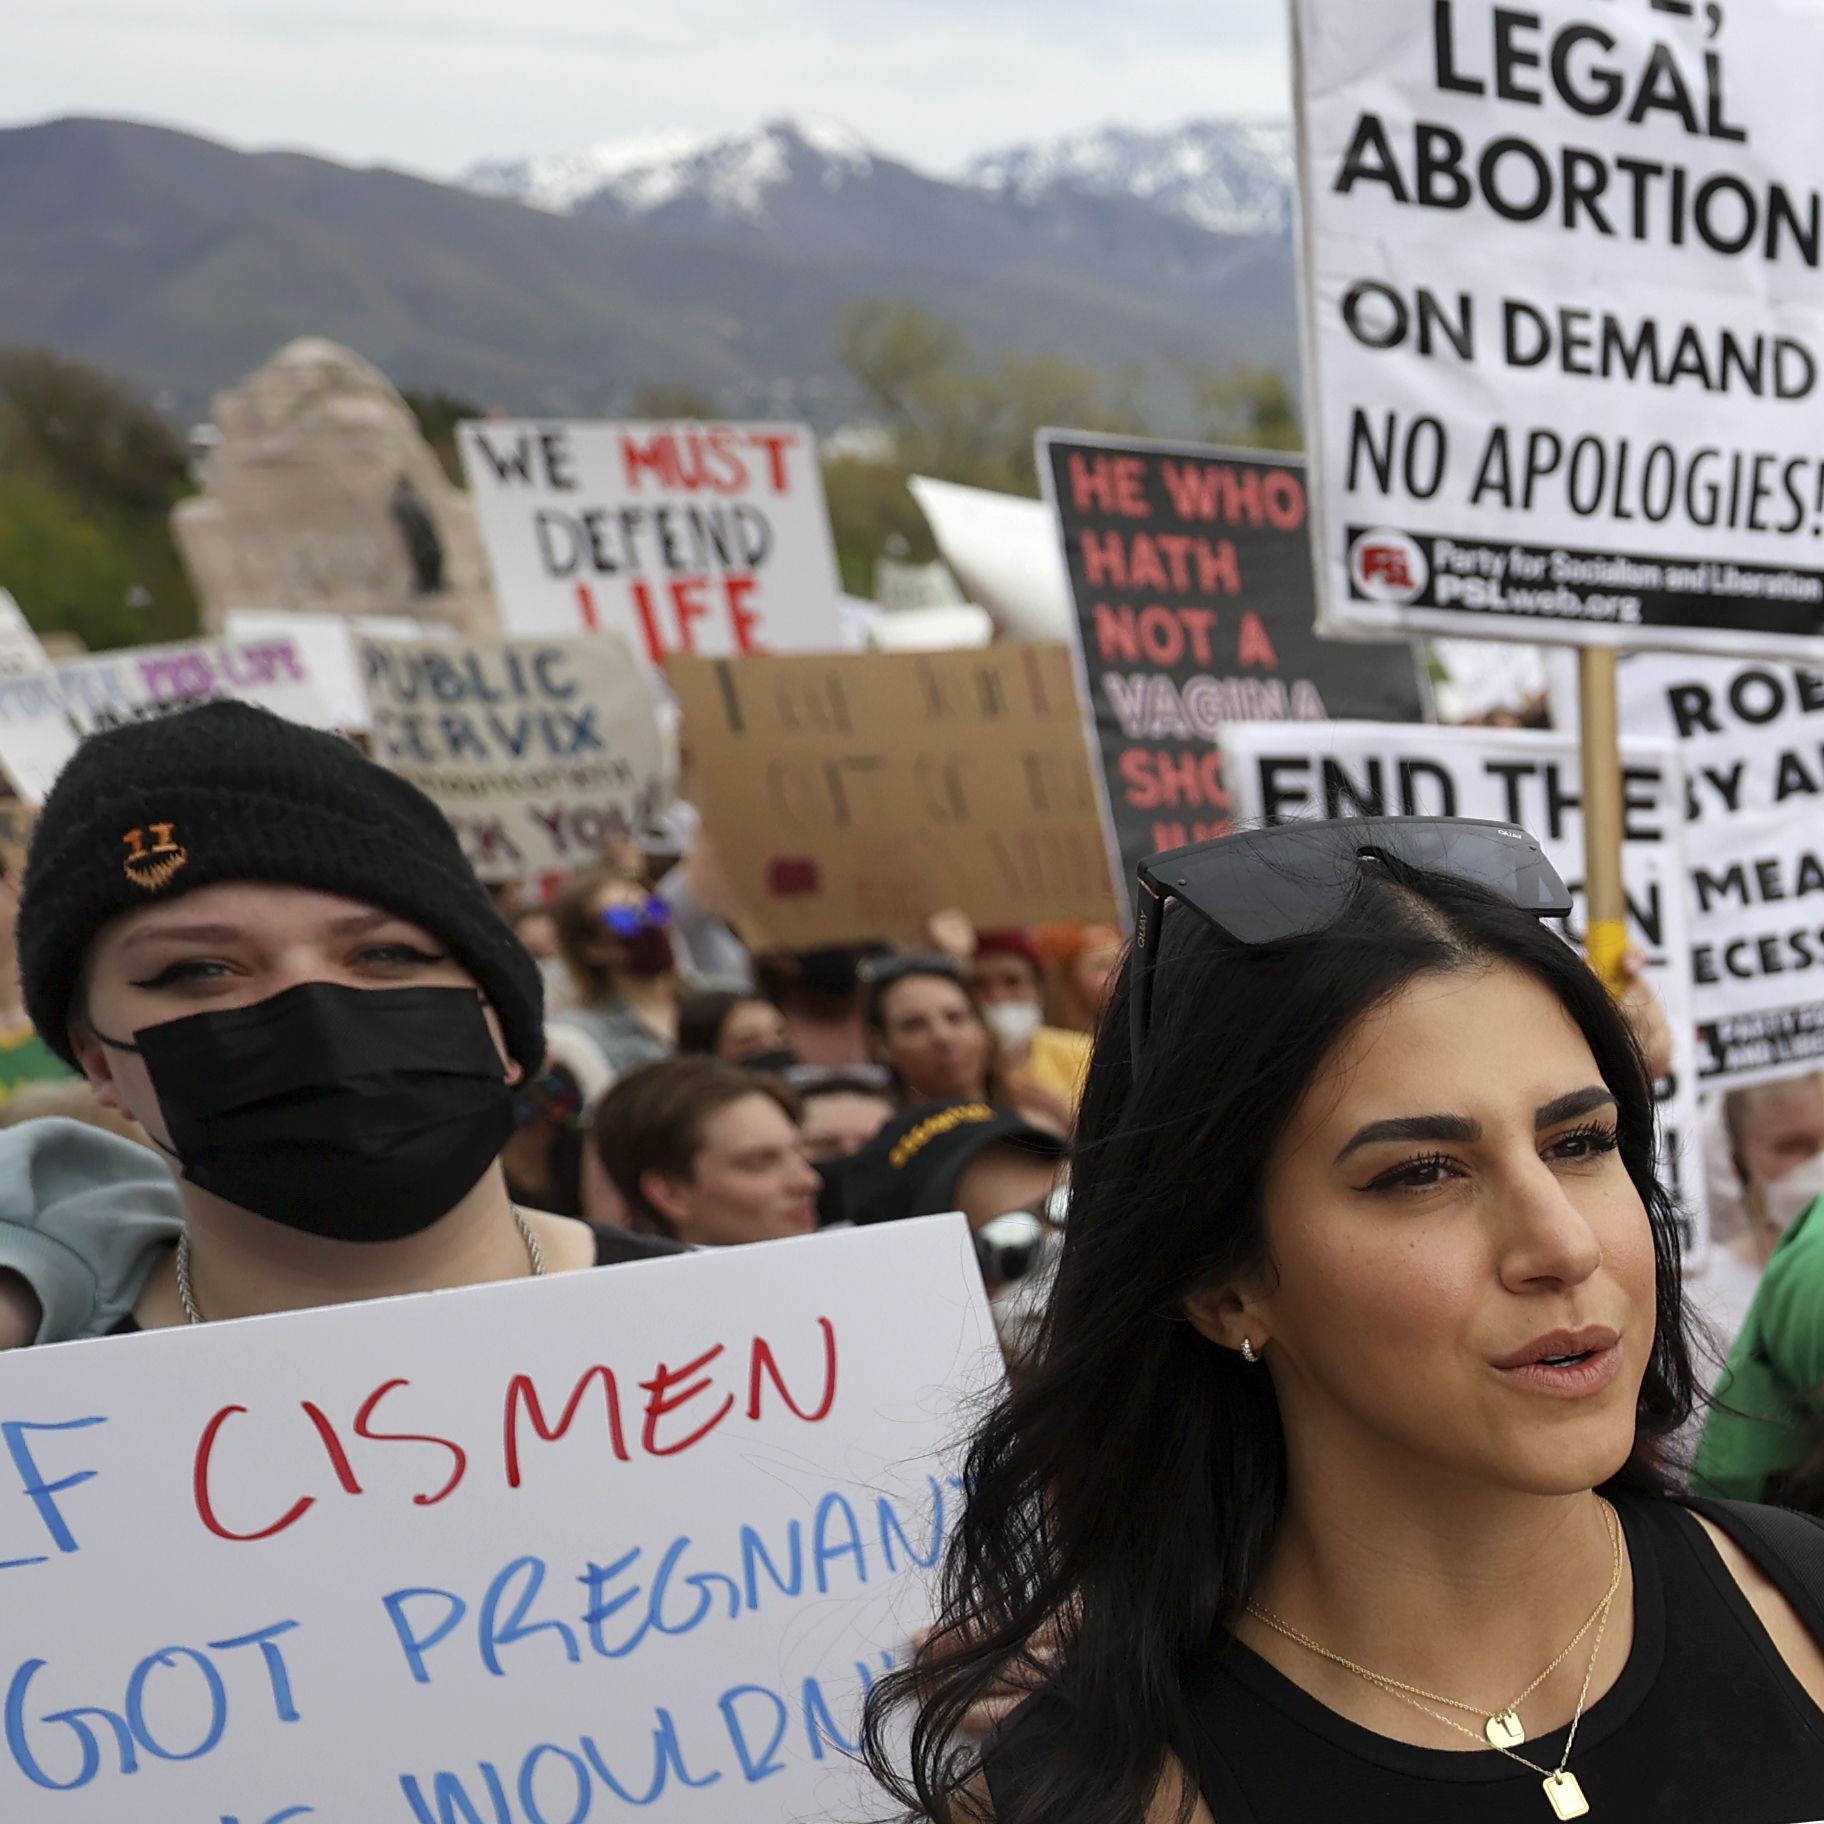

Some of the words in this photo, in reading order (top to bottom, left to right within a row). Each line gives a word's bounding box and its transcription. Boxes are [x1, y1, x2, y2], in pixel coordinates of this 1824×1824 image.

[1435, 0, 1747, 142] LEGAL
[1334, 112, 1820, 267] ABORTION
[1342, 280, 1474, 361] ON
[1504, 301, 1816, 400] DEMAND
[473, 426, 575, 490] WE
[619, 424, 798, 495] MUST
[1347, 406, 1445, 500] NO
[1069, 452, 1150, 518] HE
[1162, 460, 1307, 530] WHO
[535, 503, 773, 577] DEFEND
[1081, 529, 1241, 596] HATH
[1434, 540, 1507, 578] Party
[1510, 546, 1549, 576] for
[1551, 551, 1659, 588] Socialism
[1666, 562, 1707, 590] and
[1712, 563, 1824, 600] Liberation
[361, 639, 580, 701] PUBLIC
[1093, 603, 1216, 666] NOT
[1239, 613, 1279, 668] A
[1105, 672, 1328, 740] VAGINA
[1258, 759, 1455, 817] END
[194, 1378, 467, 1542] CIS
[503, 1316, 838, 1489] MEN
[4, 1618, 303, 1790] GOT
[383, 1473, 982, 1685] PREGNAN
